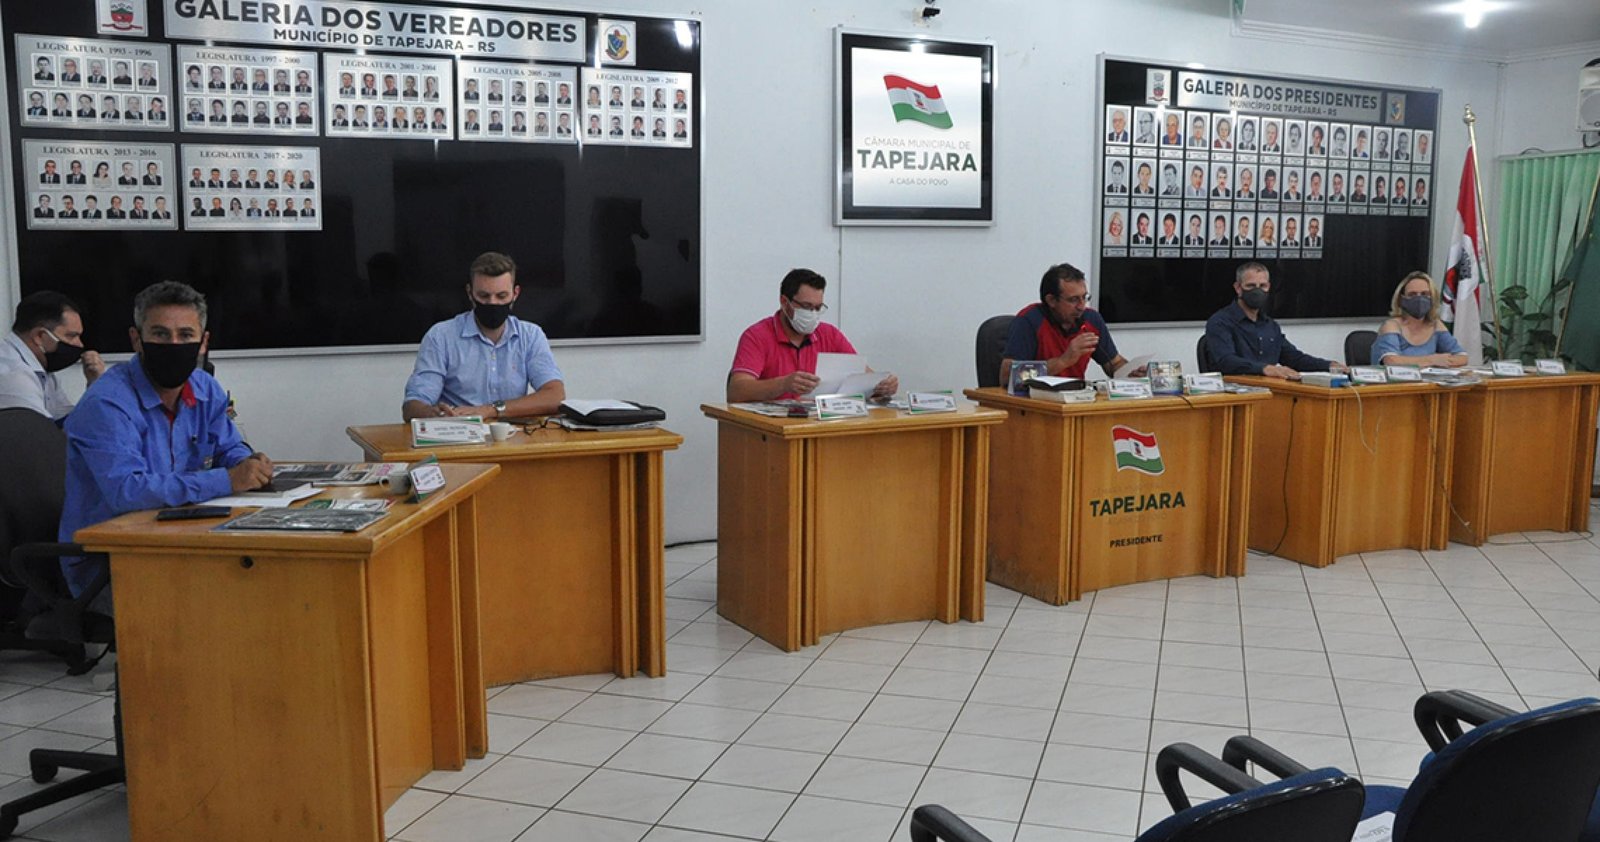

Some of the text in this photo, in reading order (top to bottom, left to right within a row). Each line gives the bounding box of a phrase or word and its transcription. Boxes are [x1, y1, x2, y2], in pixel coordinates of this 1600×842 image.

[175, 0, 314, 26] GALERIA
[321, 6, 382, 30] DOS
[389, 12, 578, 42] VEREADORES
[274, 28, 359, 44] MUNICÍPIO
[363, 34, 383, 46] DE
[387, 36, 464, 50] TAPEJARA
[478, 41, 495, 52] RS
[36, 42, 104, 54] LEGISLATURA
[109, 47, 126, 55] 1993
[135, 48, 152, 56] 1996
[196, 51, 256, 62] LEGISLATURA
[261, 55, 277, 63] 1997
[340, 60, 396, 70] LEGISLATURA
[473, 66, 525, 76] LEGISLATURA
[596, 72, 644, 82] LEGISLATURA
[1183, 78, 1378, 110] GALERIA DOS PRESIDENTES
[1229, 99, 1271, 112] MUNICÍPIO
[1273, 103, 1283, 113] DE
[1285, 104, 1322, 116] TAPEJARA
[1328, 108, 1337, 116] RS
[864, 135, 971, 150] CÂMARA MUNICIPAL DE
[43, 146, 109, 156] LEGISLATURA
[139, 149, 157, 157] 2016
[200, 150, 259, 159] LEGISLATURA
[857, 149, 977, 172] TAPEJARA
[917, 178, 928, 186] DO
[929, 178, 948, 186] POVO
[1089, 491, 1186, 517] TAPEJARA
[1110, 534, 1163, 548] PRESIDENTE
